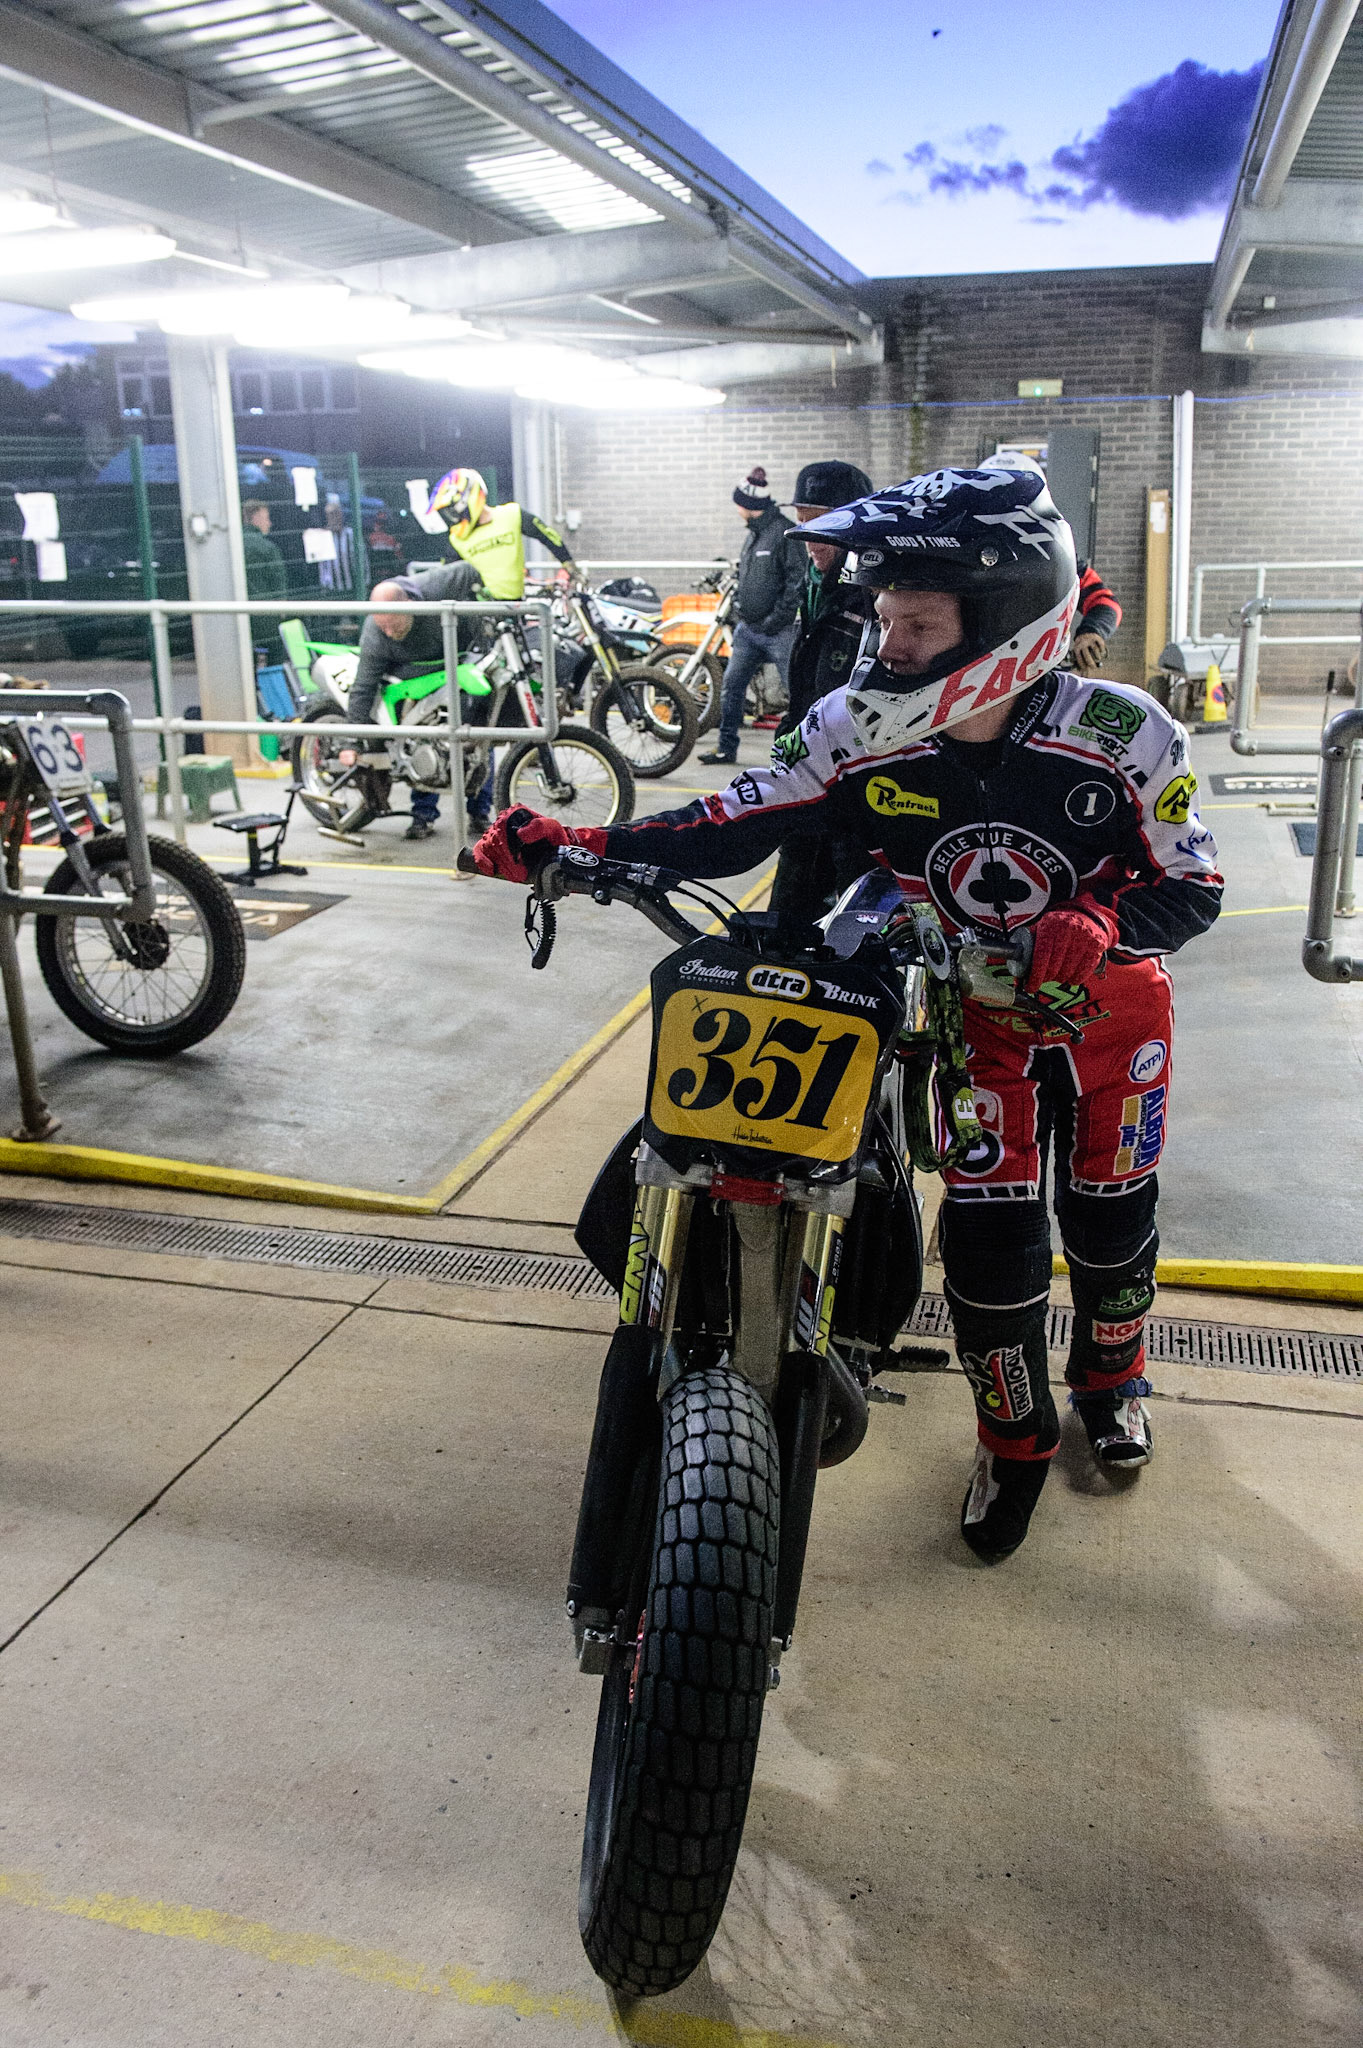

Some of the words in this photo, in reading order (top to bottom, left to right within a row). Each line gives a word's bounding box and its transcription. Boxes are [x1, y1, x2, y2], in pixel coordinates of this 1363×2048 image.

[885, 535, 919, 548] GOOD
[924, 536, 961, 548] TIMES
[862, 553, 881, 563] BELL
[27, 724, 84, 775] 63
[1067, 725, 1129, 756] BIKERIGHT
[873, 782, 937, 816] Rentruck
[1083, 792, 1098, 817] 1
[933, 837, 970, 874] BELLE
[975, 832, 1014, 846] VUE
[1020, 841, 1063, 874] ACES
[679, 958, 739, 980] Indian
[680, 974, 735, 986] MOTORCYCLE
[751, 969, 806, 994] dtra
[822, 984, 881, 1009] BRINK
[667, 1007, 861, 1132] 351
[1137, 1051, 1161, 1075] ATPI
[1119, 1124, 1139, 1148] plc
[1138, 1085, 1166, 1169] ALBON
[1102, 1298, 1134, 1310] ROCK
